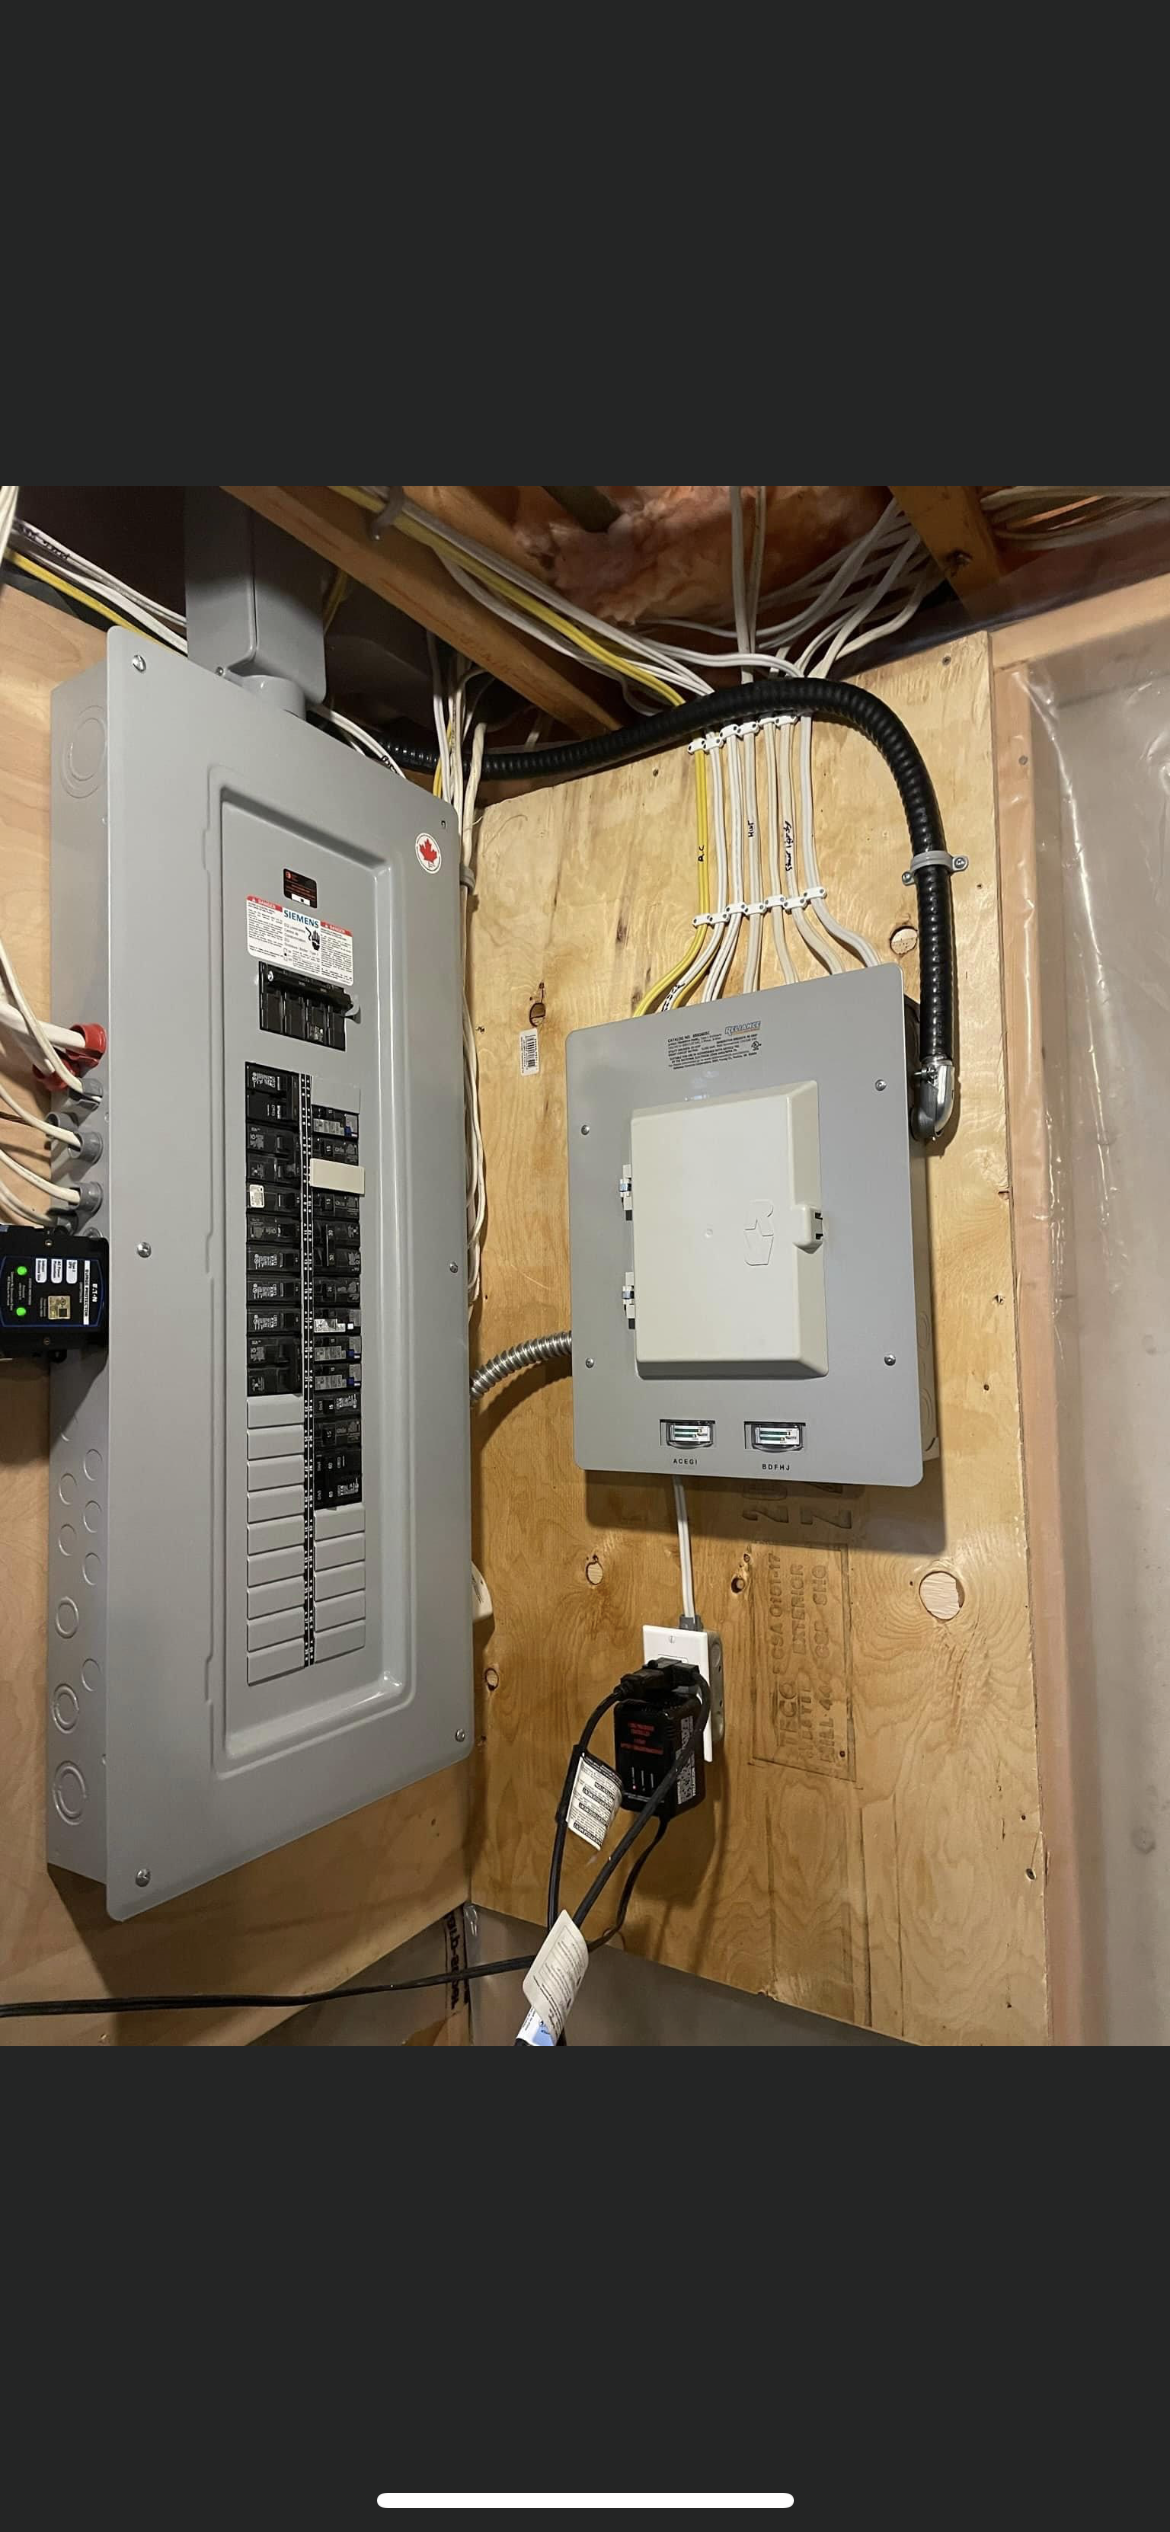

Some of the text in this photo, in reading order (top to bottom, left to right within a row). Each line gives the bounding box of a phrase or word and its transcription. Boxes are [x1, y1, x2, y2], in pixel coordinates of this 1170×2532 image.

[283, 909, 320, 929] SIEMENS
[724, 1020, 761, 1036] RELIANCE
[761, 1463, 791, 1471] BDFHJ
[790, 1563, 807, 1656] EXTERIOR
